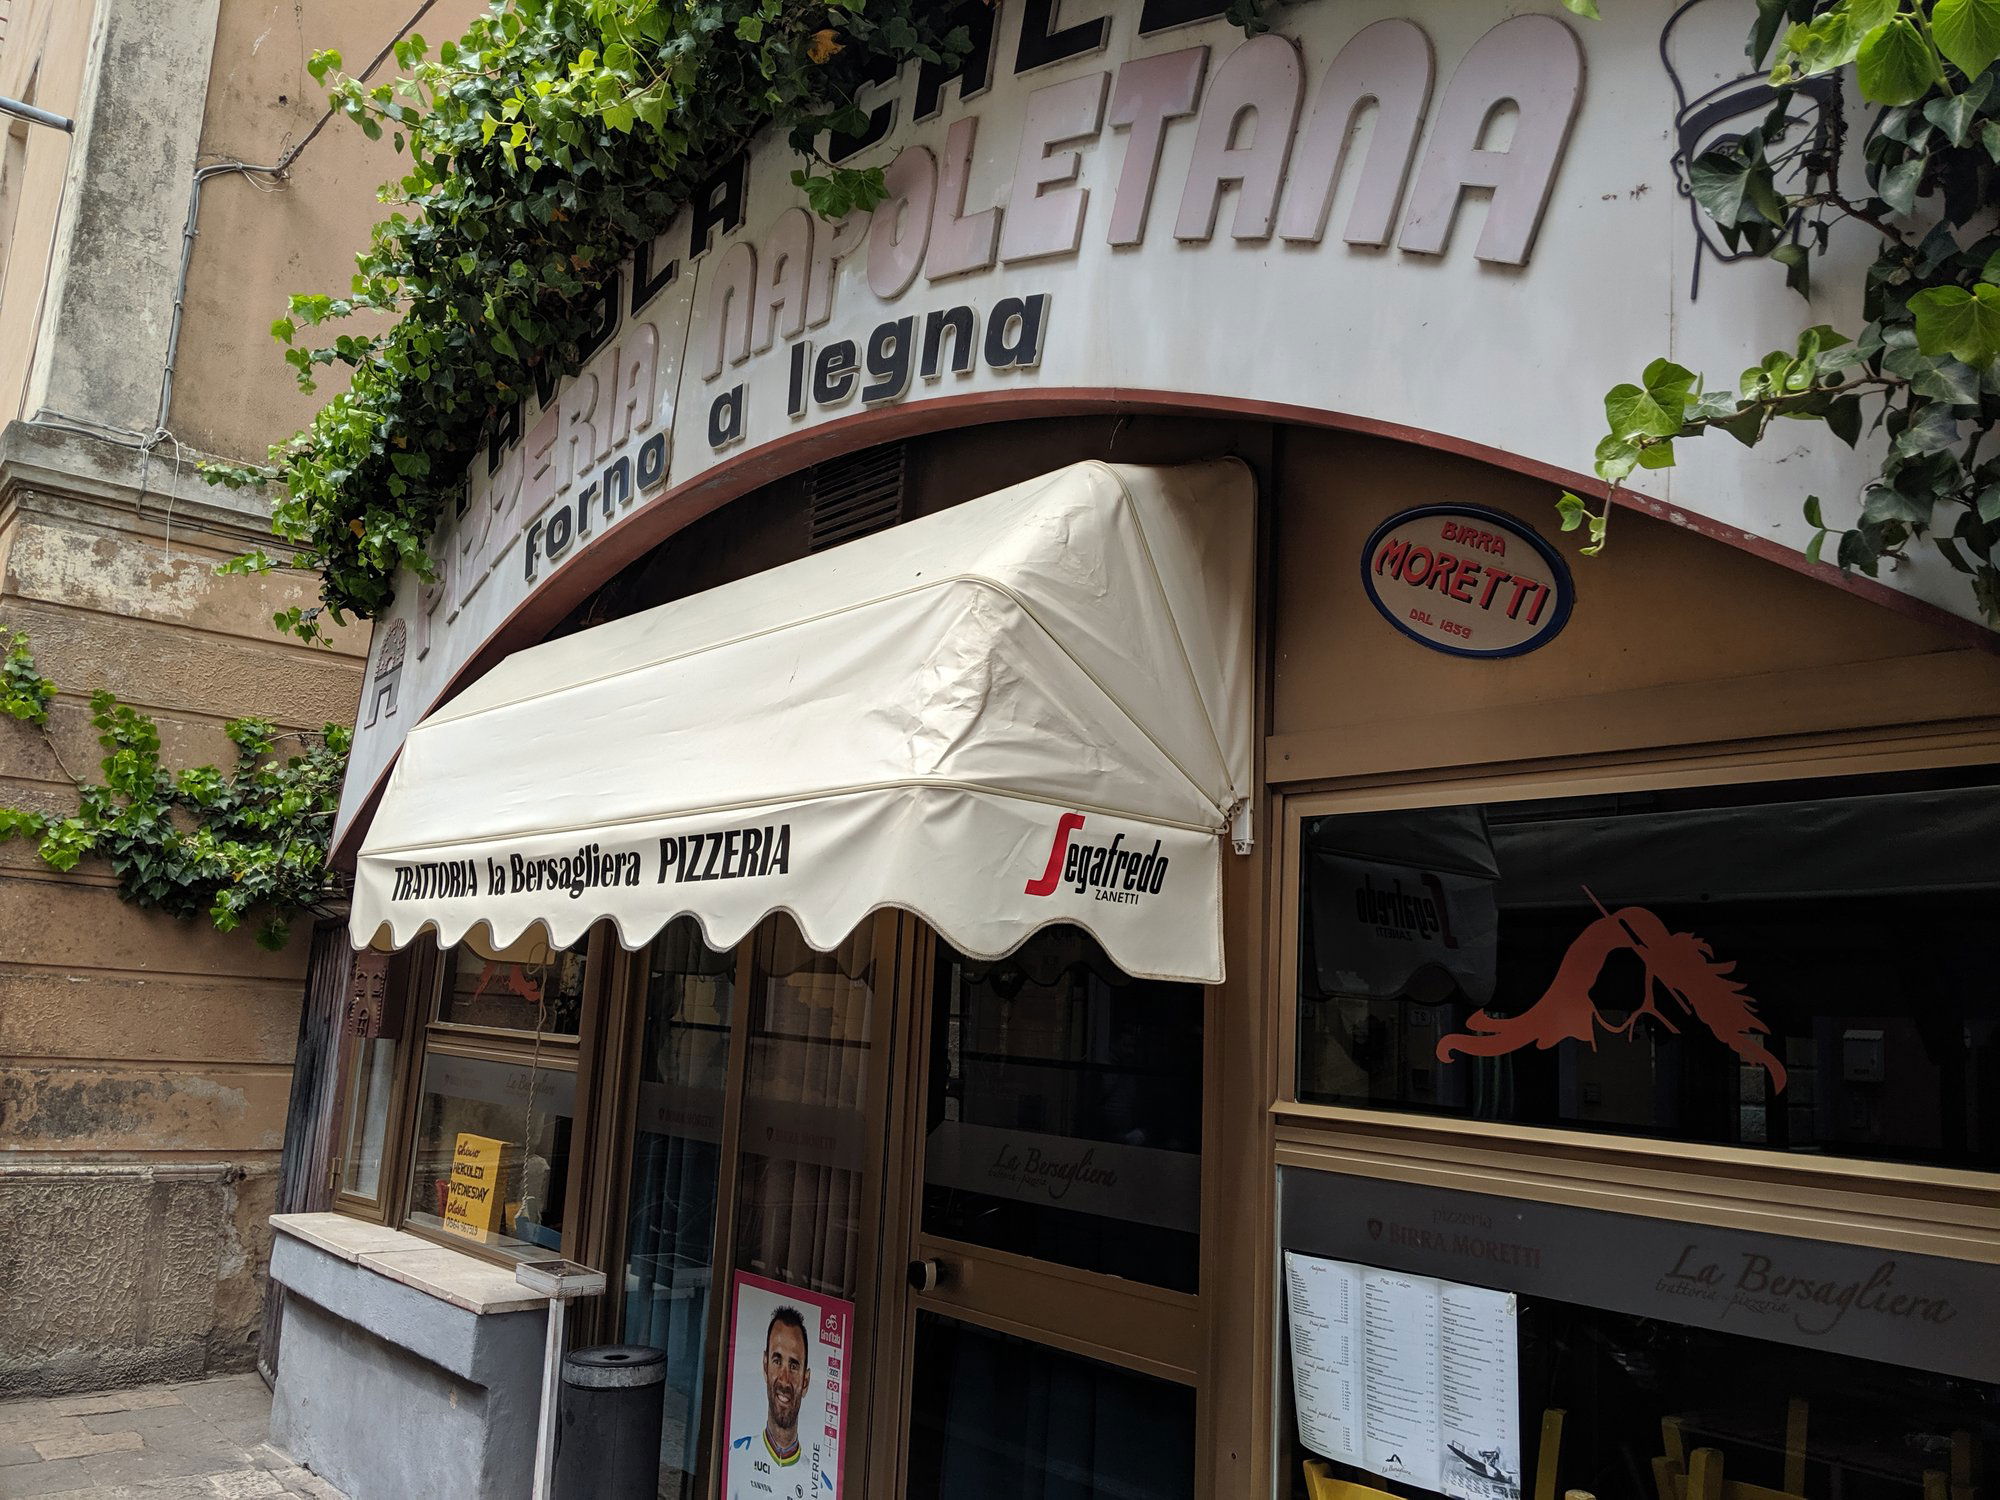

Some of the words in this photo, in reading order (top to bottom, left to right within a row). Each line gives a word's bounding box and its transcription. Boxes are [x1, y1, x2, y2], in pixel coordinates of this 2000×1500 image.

[524, 428, 672, 583] forno
[708, 381, 747, 451] a
[787, 293, 1051, 417] legna
[1440, 520, 1506, 557] BIRRA
[1375, 538, 1551, 626] MORETTI
[1409, 608, 1434, 626] DAL
[1439, 619, 1473, 640] 1859
[391, 859, 478, 901] TRATTORIA
[487, 857, 506, 896] la
[510, 843, 641, 899] Bersagliera
[657, 824, 791, 884] PIZZERIA
[1024, 813, 1169, 897] Segafredo
[1094, 889, 1139, 905] ZANETTI
[450, 1180, 490, 1203] WEDNESDAY
[1388, 1222, 1447, 1252] BIRRA
[1453, 1233, 1542, 1269] MORETTI
[1665, 1245, 1724, 1286] La
[1736, 1253, 1957, 1335] Bersagliera
